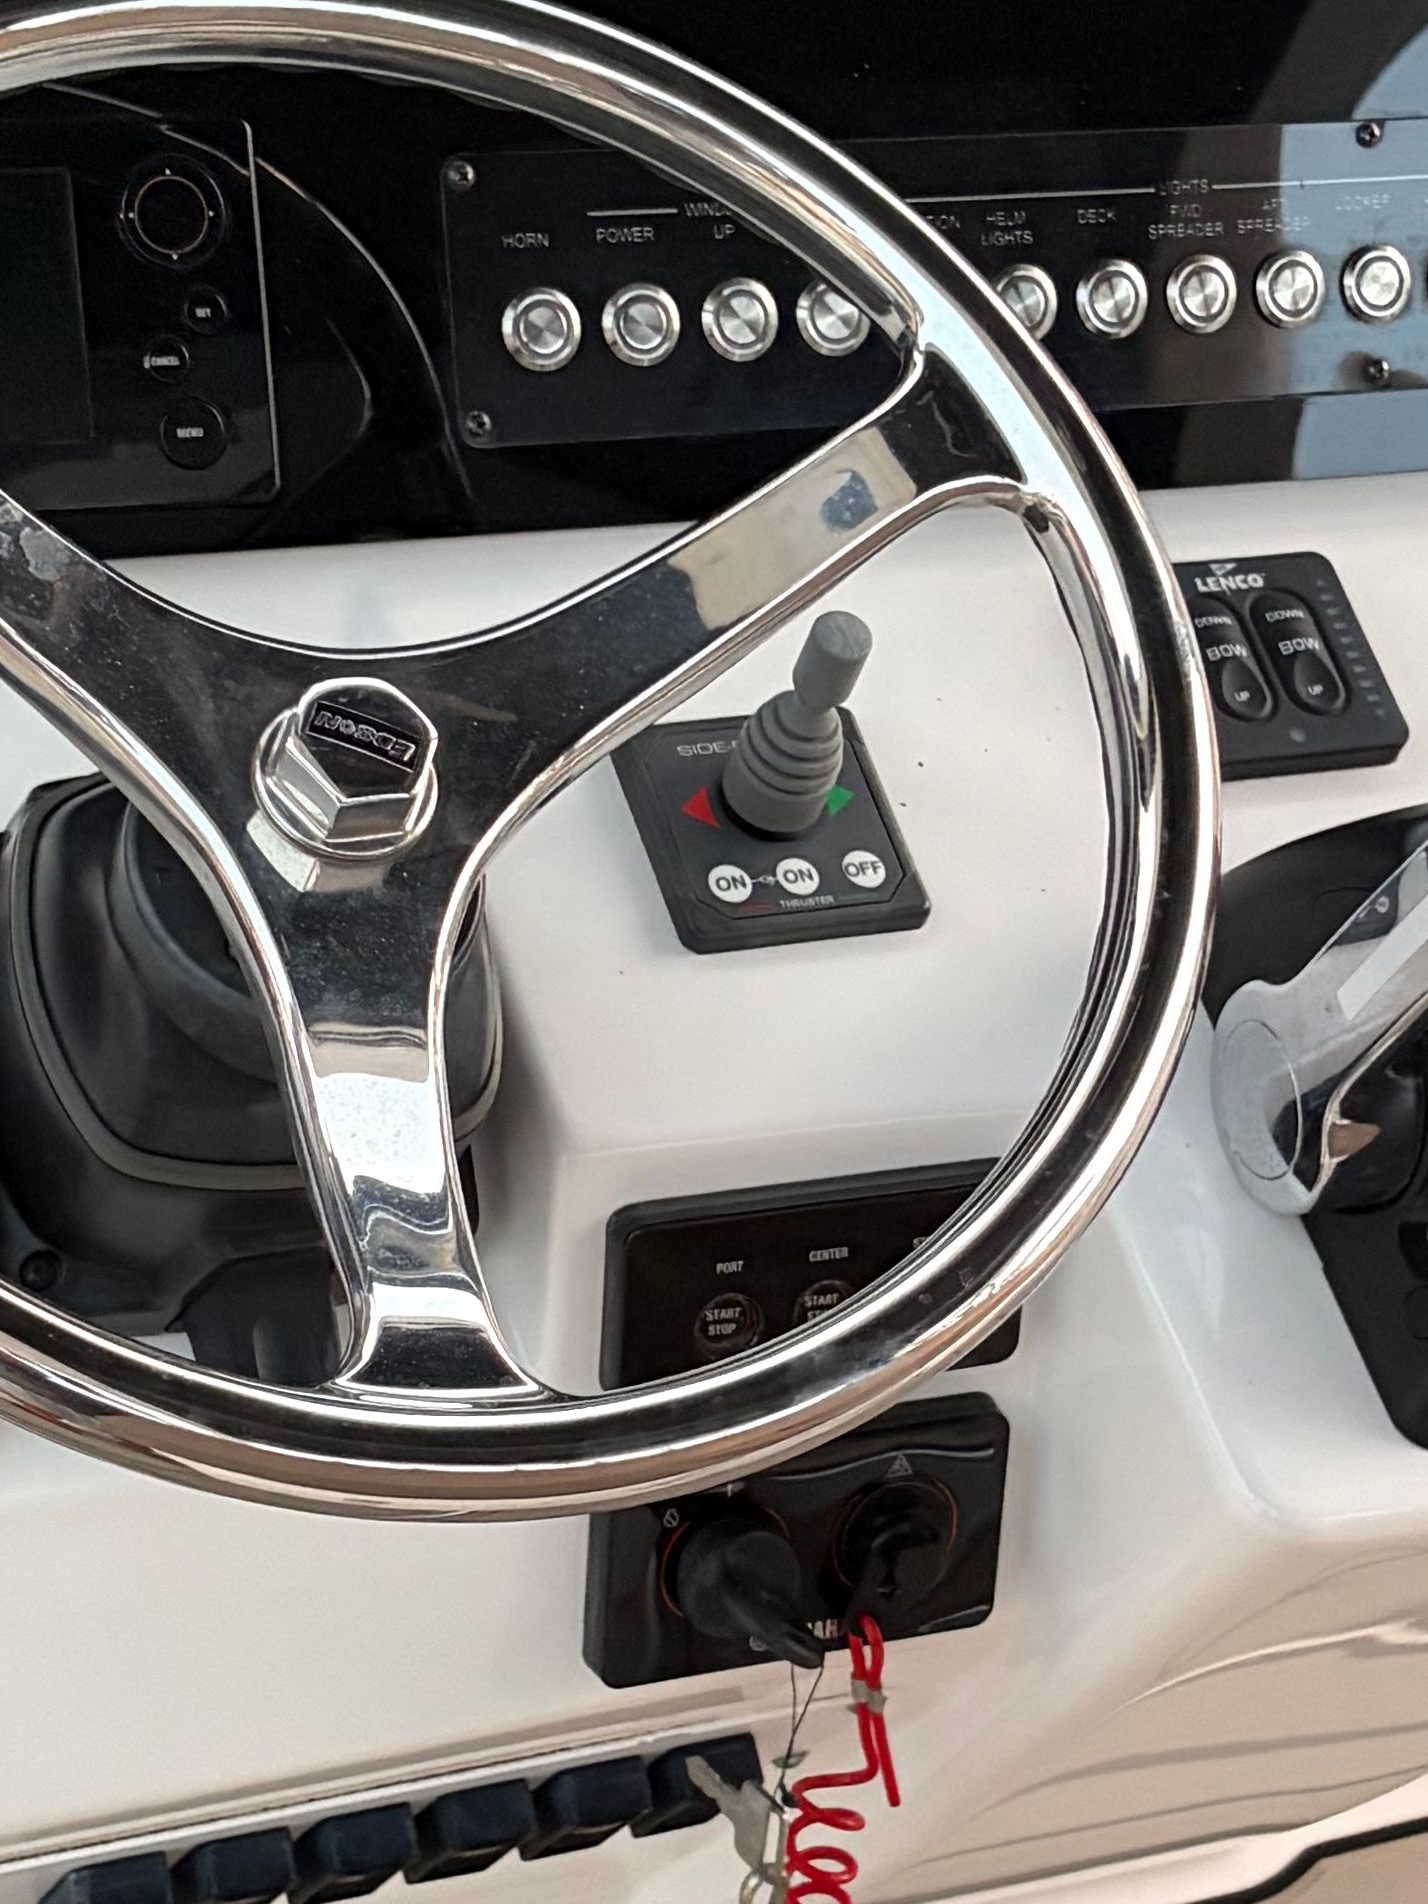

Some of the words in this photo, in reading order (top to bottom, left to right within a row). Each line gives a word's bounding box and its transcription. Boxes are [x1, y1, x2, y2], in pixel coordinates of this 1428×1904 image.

[1076, 207, 1117, 224] DECK
[595, 227, 655, 243] POWER
[713, 224, 736, 240] UP
[981, 230, 1034, 246] LIGHTS
[1147, 221, 1224, 240] SPREADER
[502, 232, 549, 248] HORN
[1194, 573, 1265, 594] LENCO
[1194, 615, 1233, 628] DOWN
[1265, 609, 1304, 623] DOWN
[1206, 643, 1248, 661] BOW
[1278, 638, 1320, 656] BOW
[1234, 690, 1251, 702] UP
[1307, 684, 1324, 696] UP
[782, 869, 815, 885] ON
[844, 860, 884, 878] OFF
[715, 877, 748, 892] ON
[778, 895, 836, 909] THRUSTER
[808, 1247, 849, 1263] CENTER
[716, 1260, 744, 1275] PORT
[804, 1293, 840, 1308] START
[705, 1306, 743, 1322] START
[708, 1322, 737, 1336] STOP
